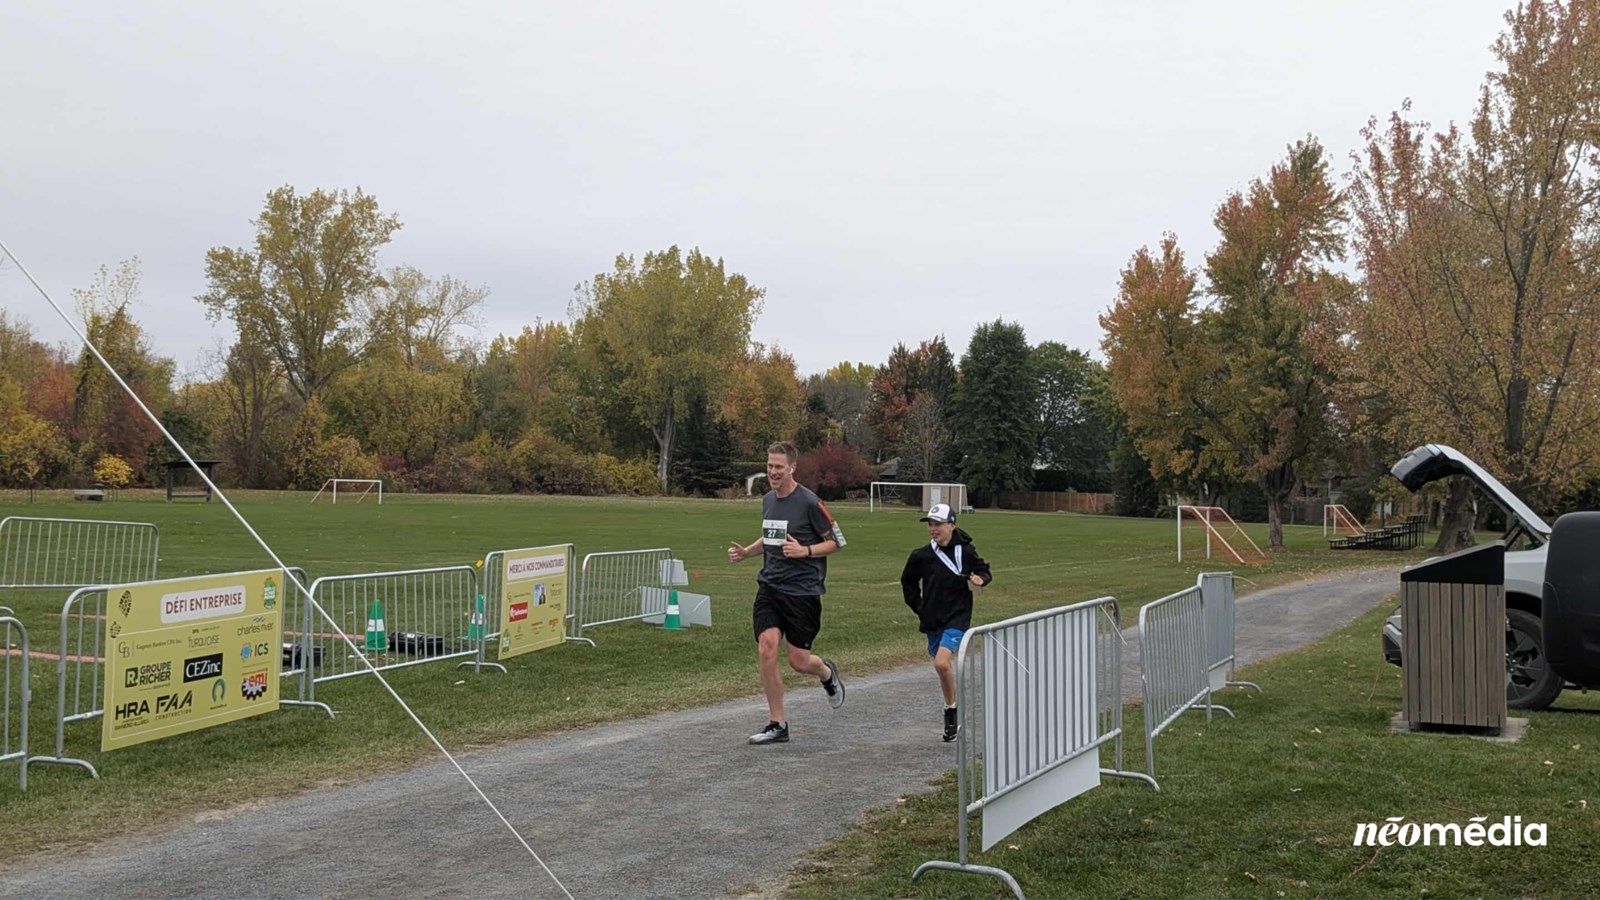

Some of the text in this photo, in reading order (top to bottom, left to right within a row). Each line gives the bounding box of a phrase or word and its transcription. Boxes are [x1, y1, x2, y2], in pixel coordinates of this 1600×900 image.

[767, 529, 777, 538] 27
[165, 596, 187, 615] DÉFI
[190, 592, 242, 611] ENTREPRISE
[236, 624, 261, 636] charles
[254, 642, 269, 657] ICS
[140, 661, 172, 675] GROUPE
[185, 659, 221, 679] CEZinc
[139, 670, 172, 686] RICHER
[115, 699, 150, 721] HRA
[156, 691, 193, 714] FAA
[155, 708, 192, 721] CONSTRUCTION
